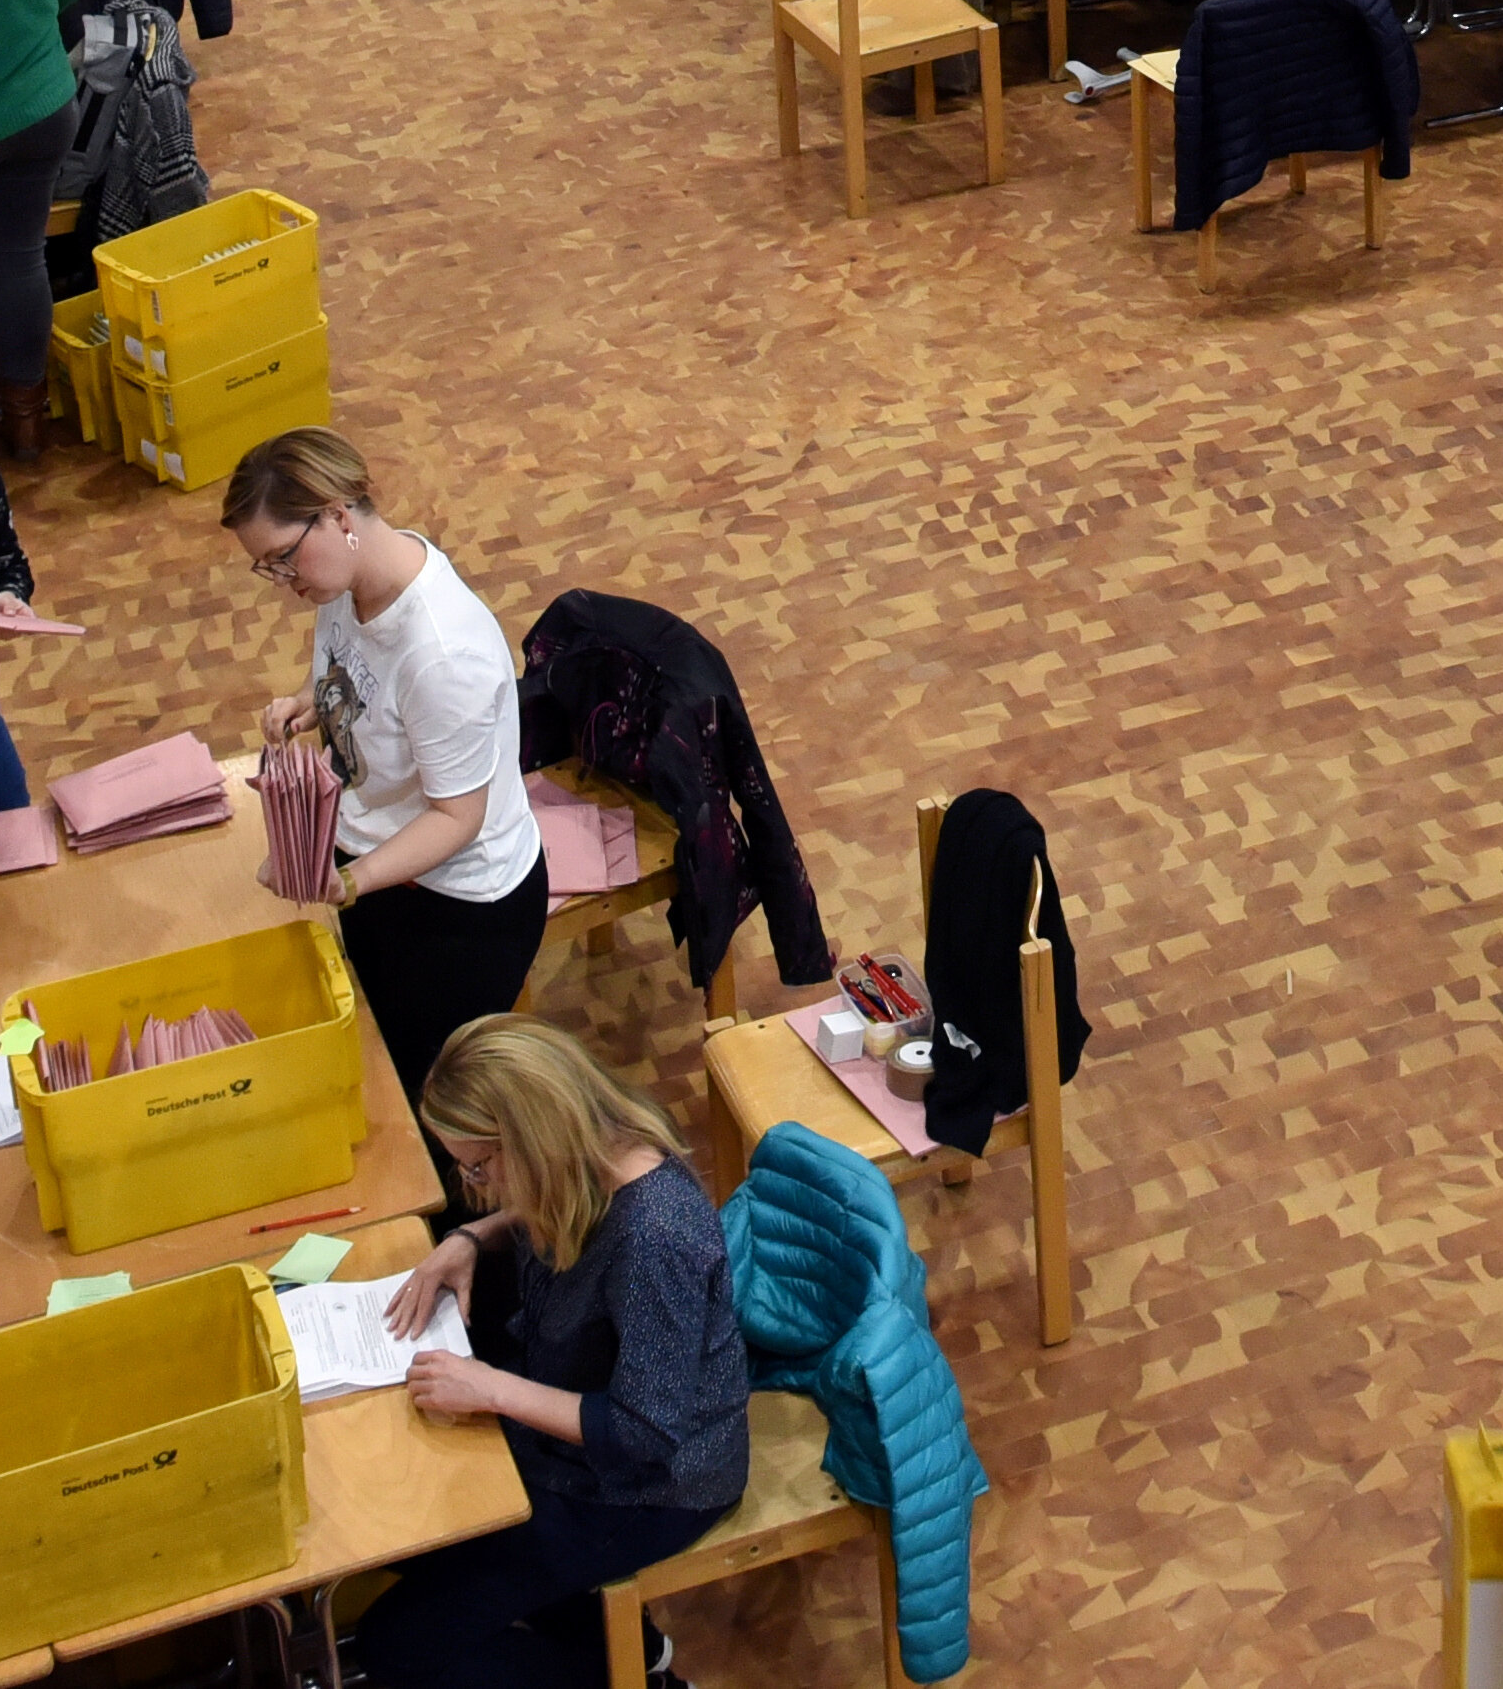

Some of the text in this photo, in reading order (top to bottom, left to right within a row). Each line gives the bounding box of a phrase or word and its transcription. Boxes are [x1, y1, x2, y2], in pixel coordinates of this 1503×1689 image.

[147, 1089, 226, 1117] Deutsche Post
[61, 1463, 149, 1497] Deutsche Post
